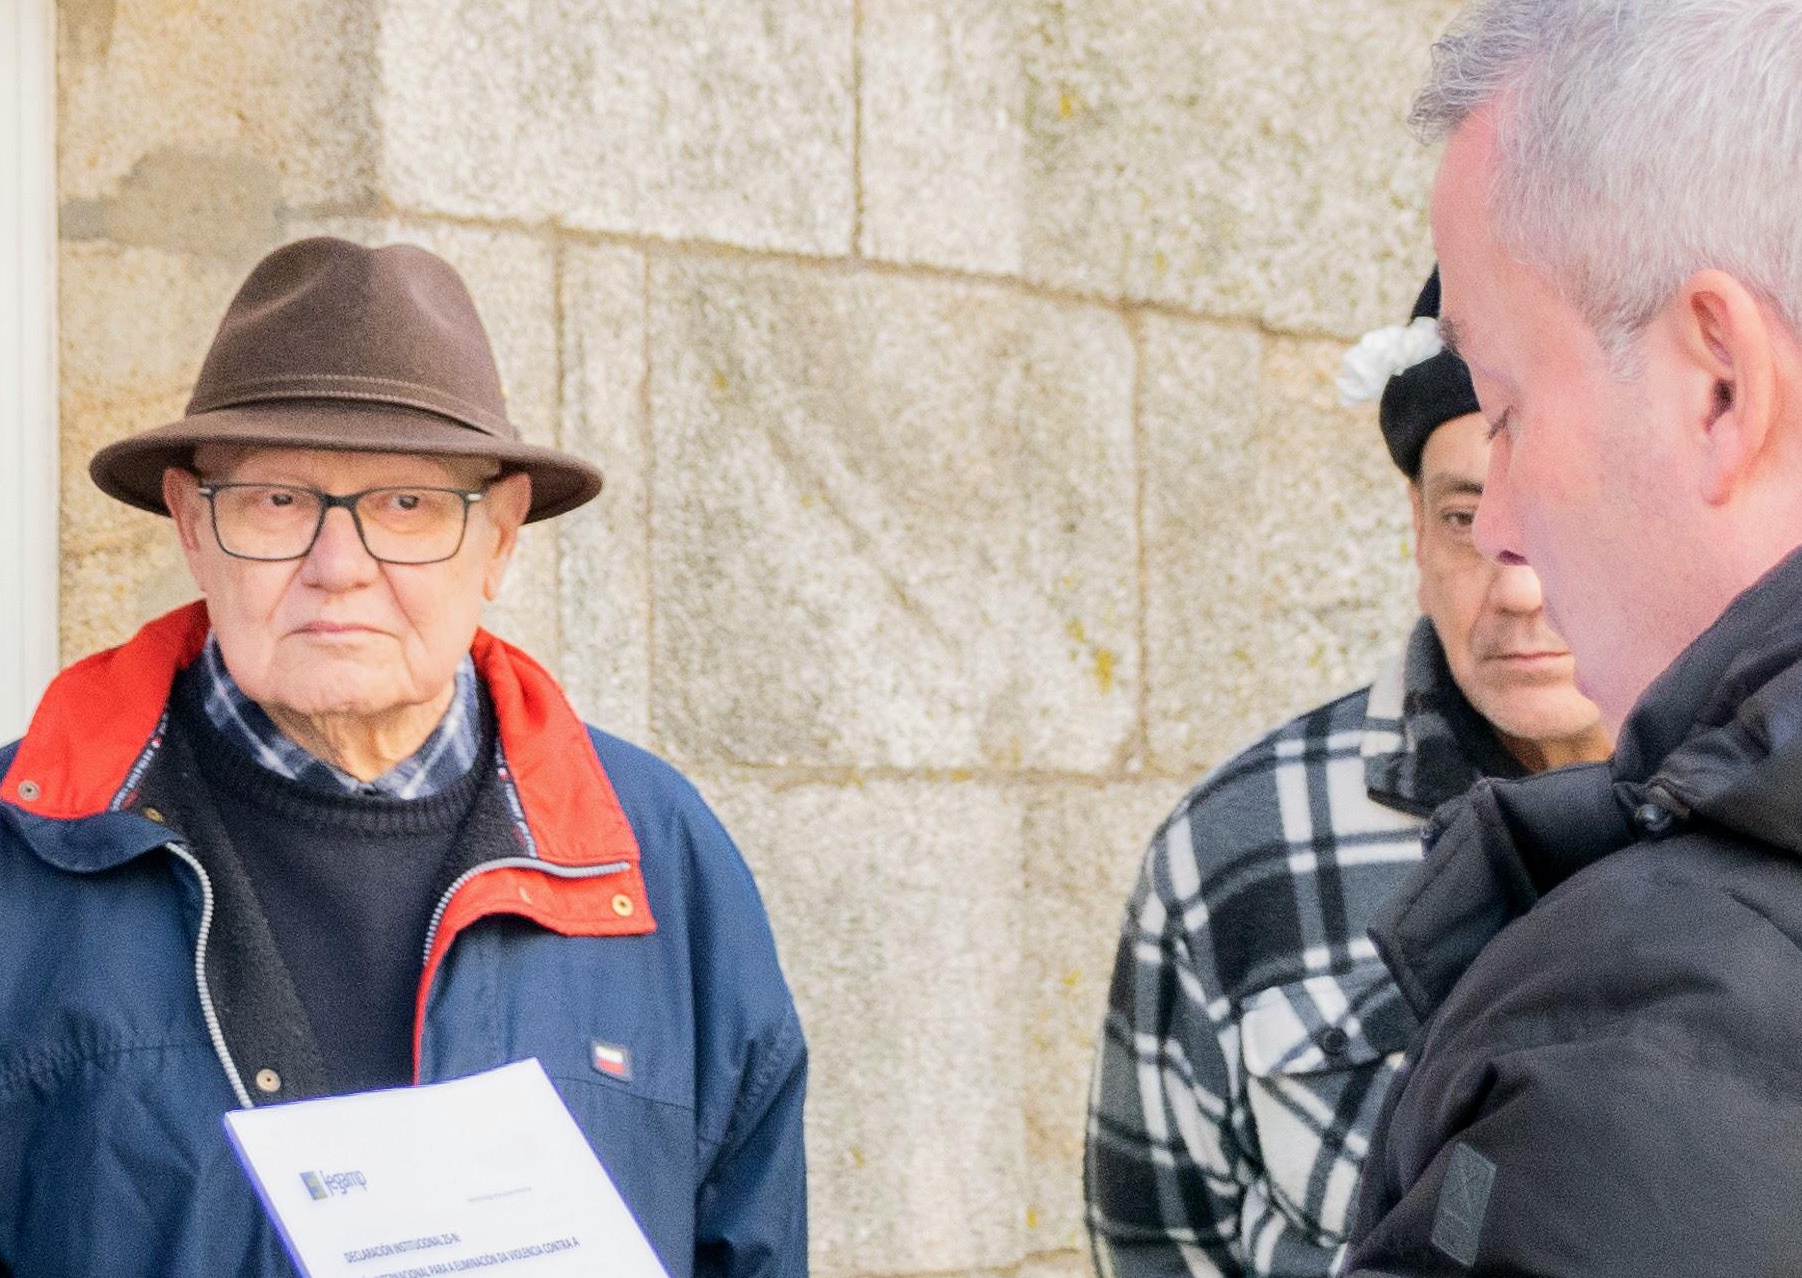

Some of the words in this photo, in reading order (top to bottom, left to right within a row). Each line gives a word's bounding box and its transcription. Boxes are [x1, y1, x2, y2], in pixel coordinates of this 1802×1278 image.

[344, 1245, 394, 1263] DECLARACIÓN
[429, 1264, 449, 1275] PARA
[453, 1255, 498, 1271] ELIMINACIÓN
[509, 1246, 544, 1260] VIOLENCIA
[543, 1239, 573, 1254] CONTRA
